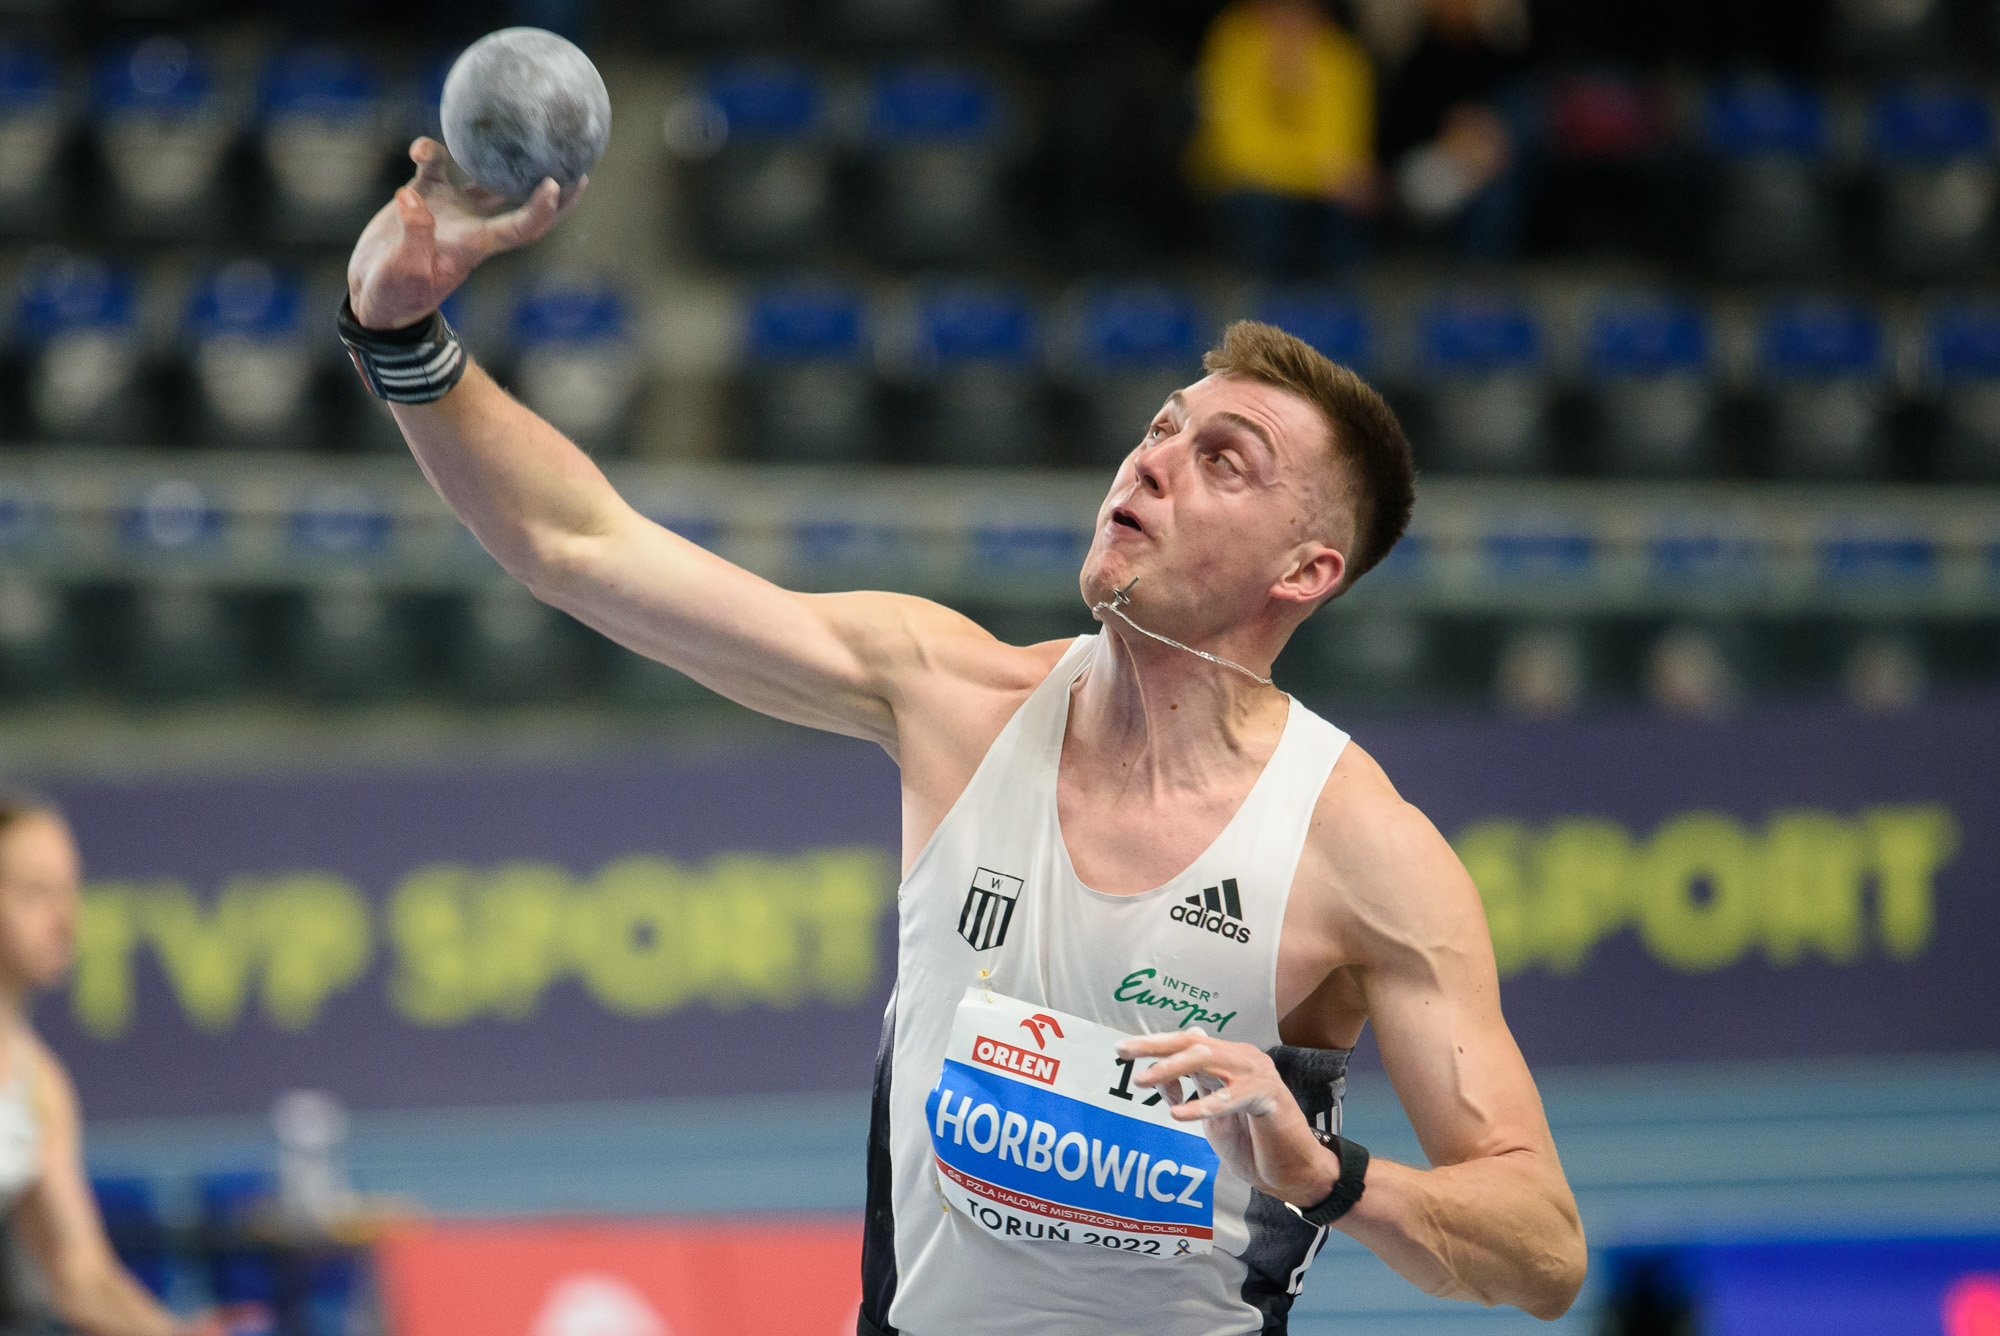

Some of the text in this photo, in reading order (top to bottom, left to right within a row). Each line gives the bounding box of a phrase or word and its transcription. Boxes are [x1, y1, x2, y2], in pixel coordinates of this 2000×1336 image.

[70, 844, 890, 1040] TVP SPORT
[1170, 905, 1251, 944] adidas
[1113, 967, 1238, 1033] Europol
[976, 1040, 1055, 1081] ORLEN
[935, 1088, 1206, 1209] HORBOWICZ
[966, 1180, 996, 1199] PZLA
[997, 1190, 1047, 1214] HALOWE
[1049, 1207, 1140, 1232] MISTRZOSTWA
[1142, 1223, 1188, 1235] POLSKI
[966, 1197, 1161, 1256] TORUŃ 2022
